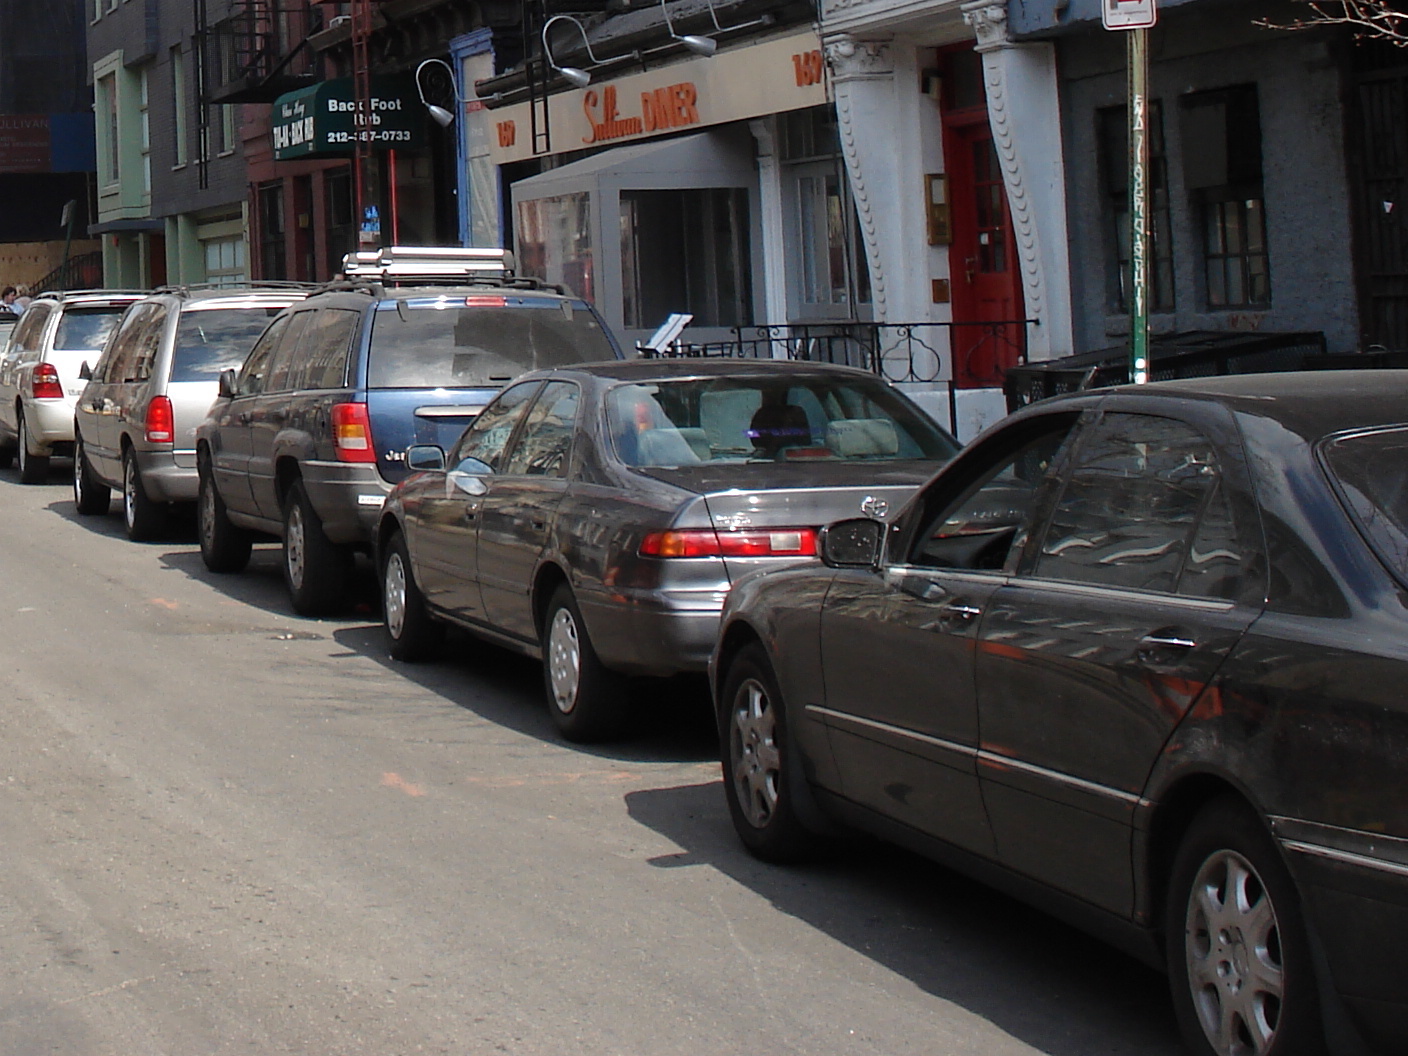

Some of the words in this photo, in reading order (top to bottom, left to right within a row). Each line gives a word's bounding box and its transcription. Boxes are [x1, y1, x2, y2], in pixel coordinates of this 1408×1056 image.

[792, 50, 822, 87] 169
[371, 97, 402, 111] Foot
[641, 81, 700, 132] DINER
